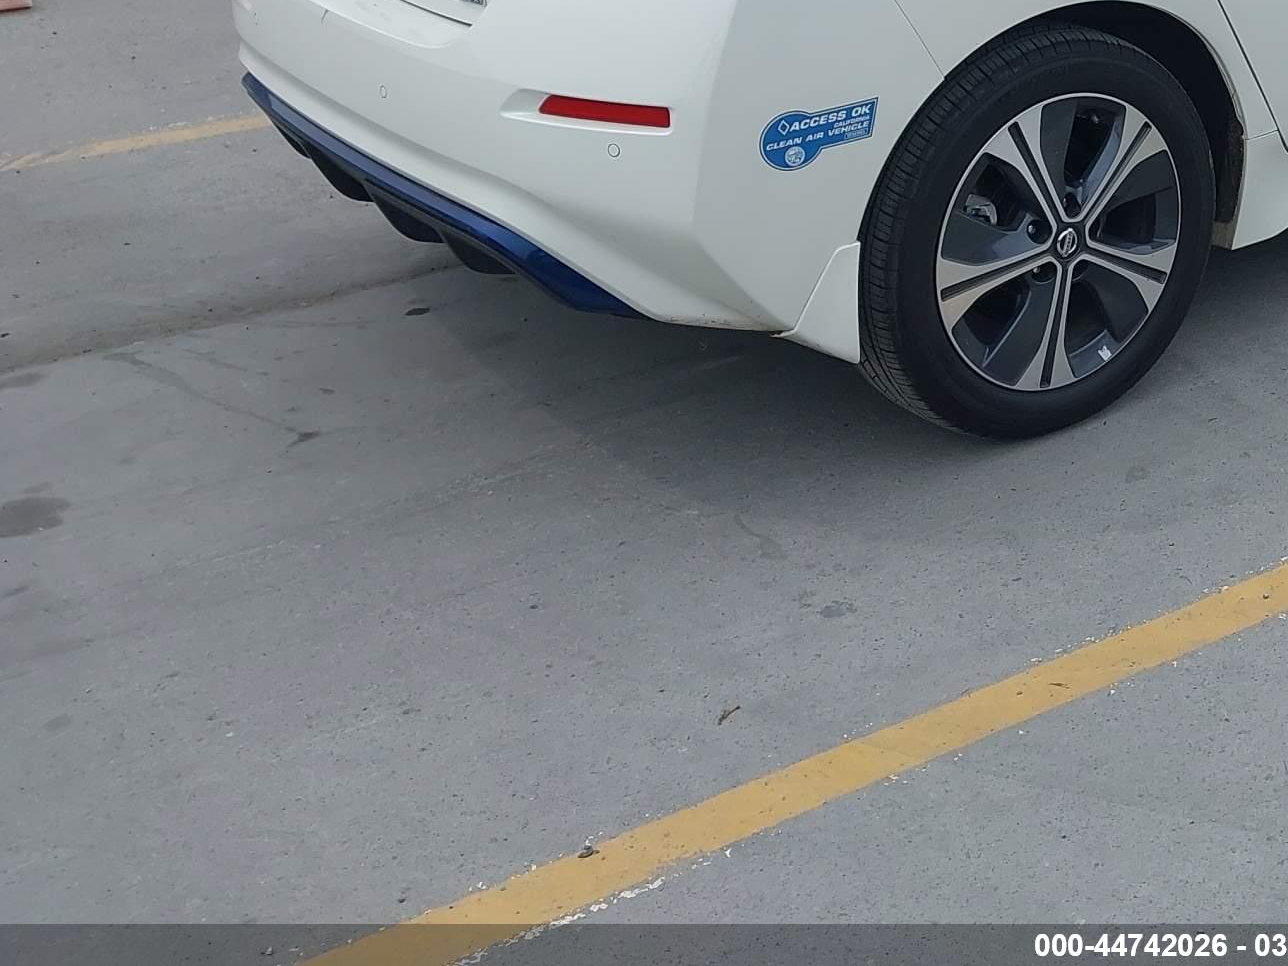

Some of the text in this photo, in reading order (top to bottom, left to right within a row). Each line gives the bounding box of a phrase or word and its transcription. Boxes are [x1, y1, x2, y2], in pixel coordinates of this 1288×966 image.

[790, 104, 871, 131] ACCESS OK
[766, 137, 802, 150] CLEAN
[805, 132, 824, 143] AIR
[828, 121, 869, 137] VEHICLE
